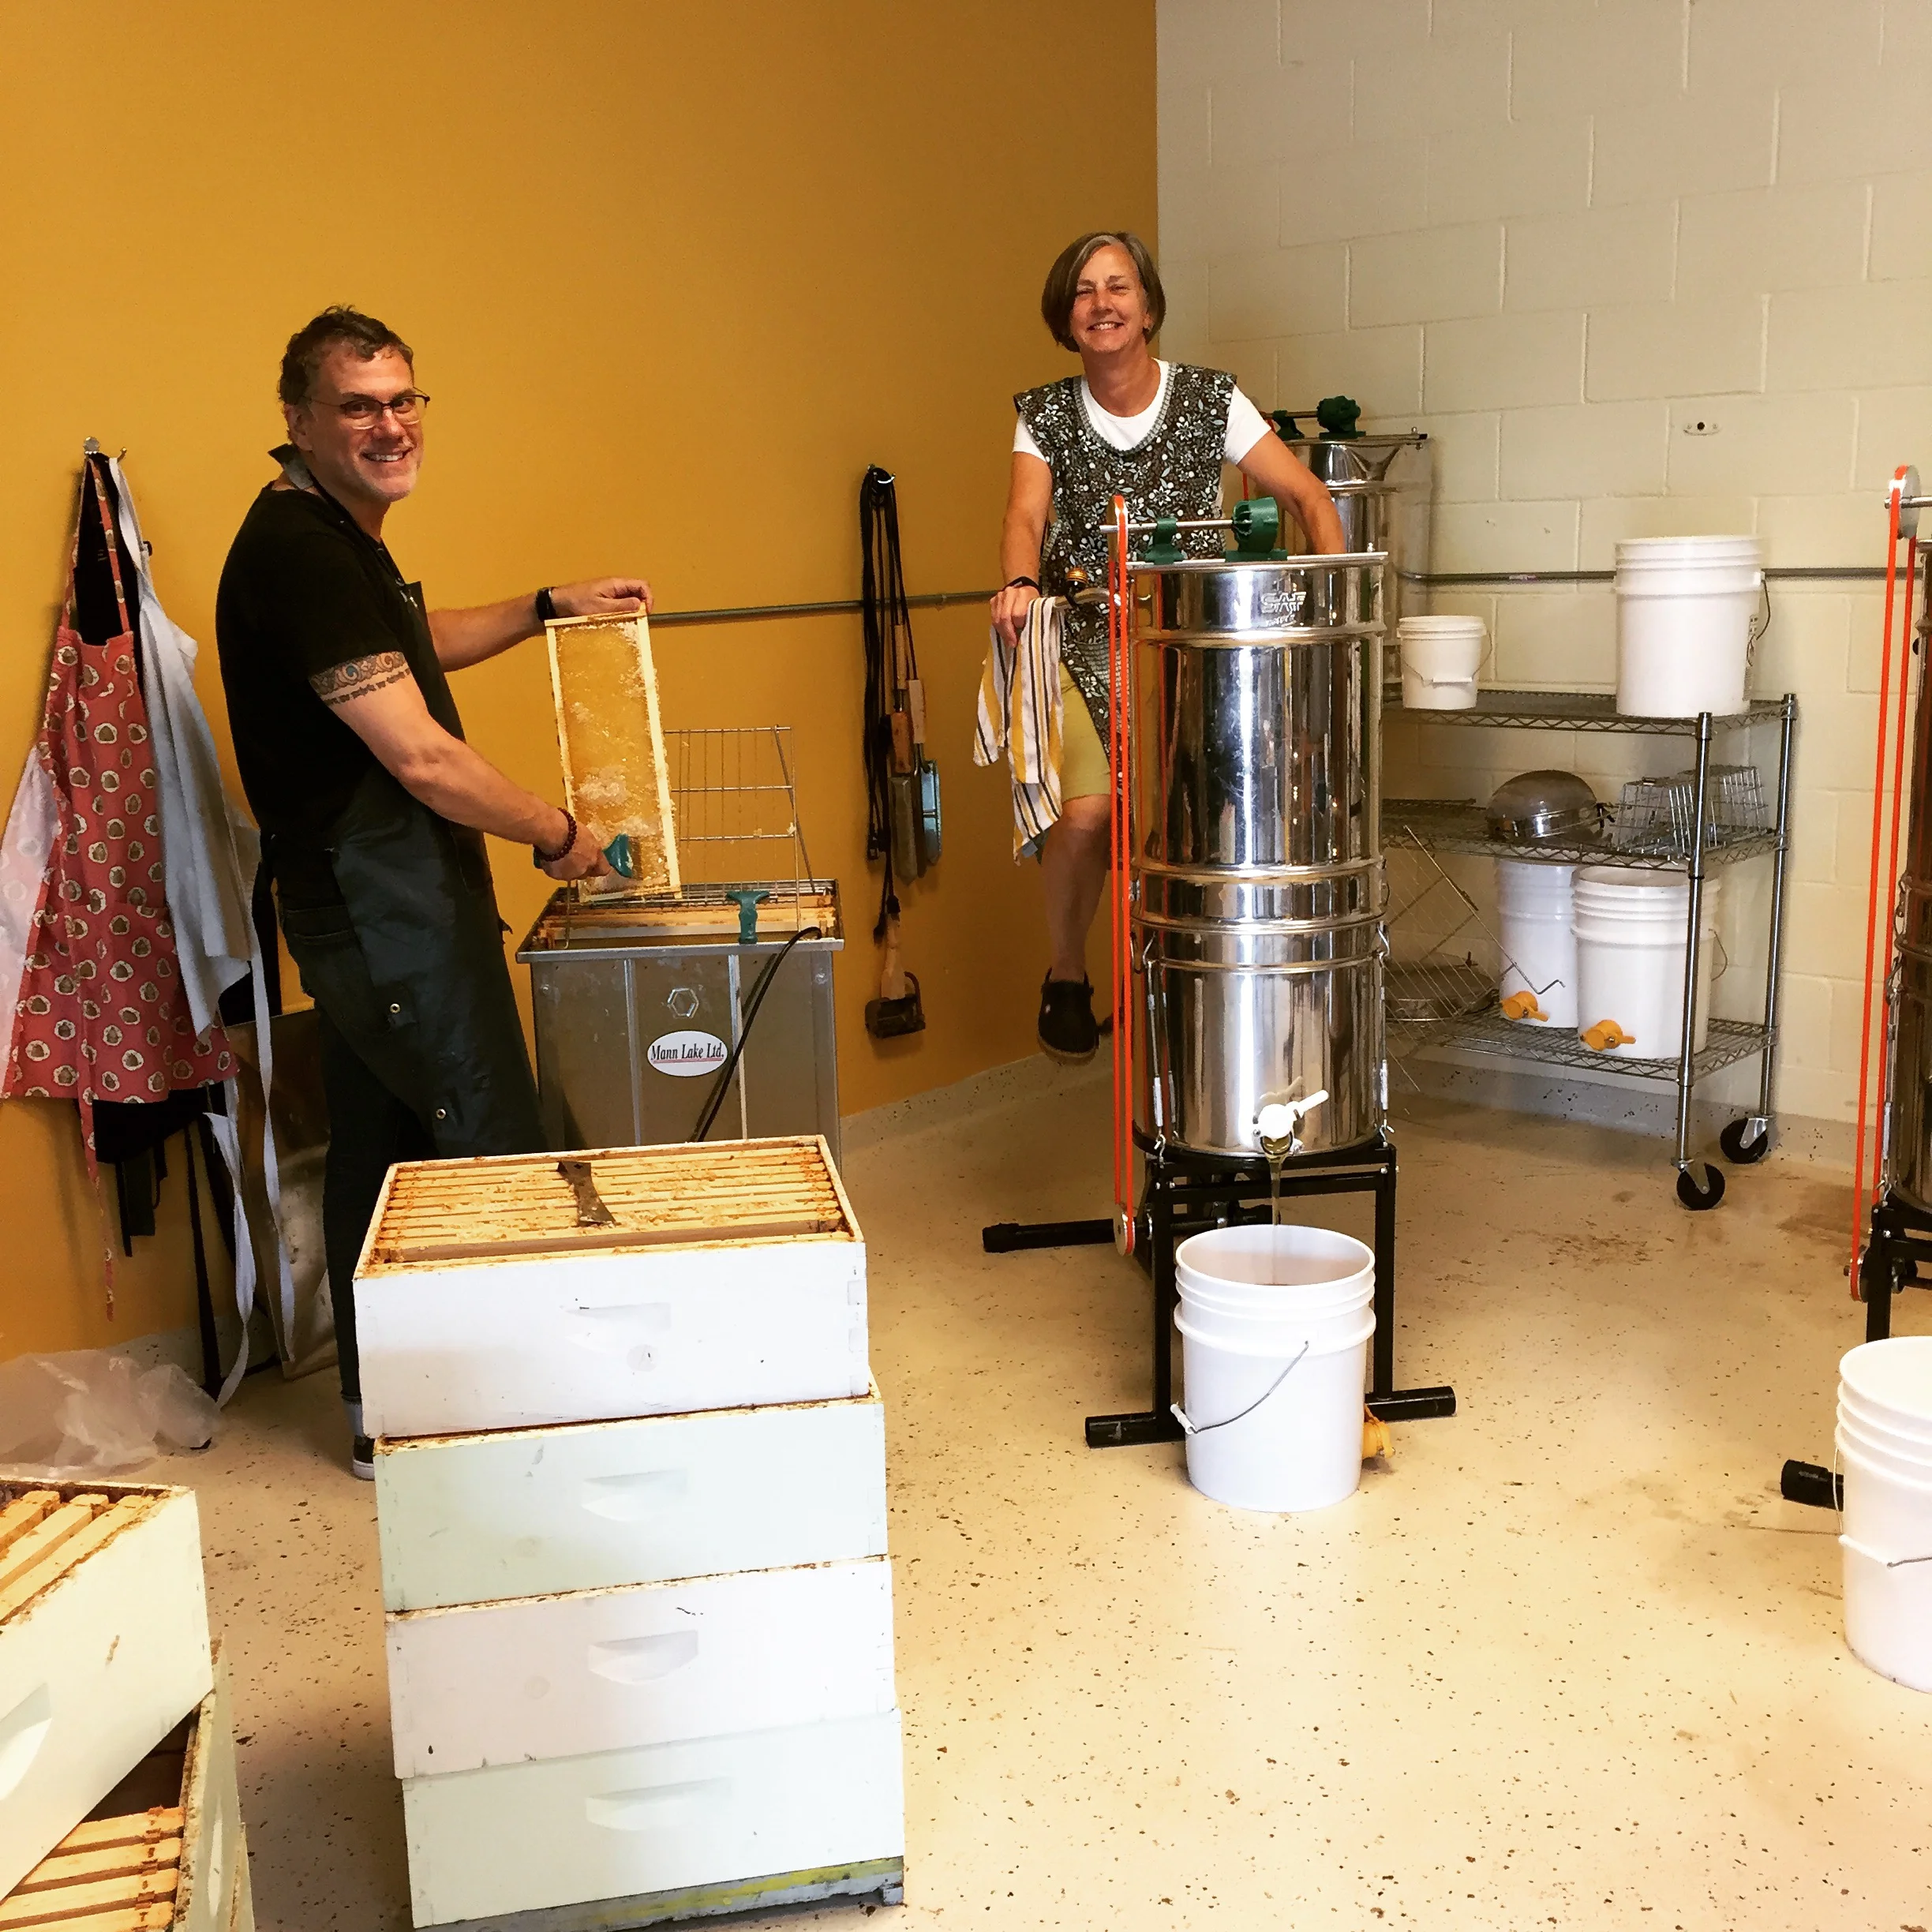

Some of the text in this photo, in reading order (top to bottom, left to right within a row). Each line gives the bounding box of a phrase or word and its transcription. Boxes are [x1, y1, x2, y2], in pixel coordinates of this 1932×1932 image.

[650, 1043, 724, 1060] Mann Lake Ltd.
